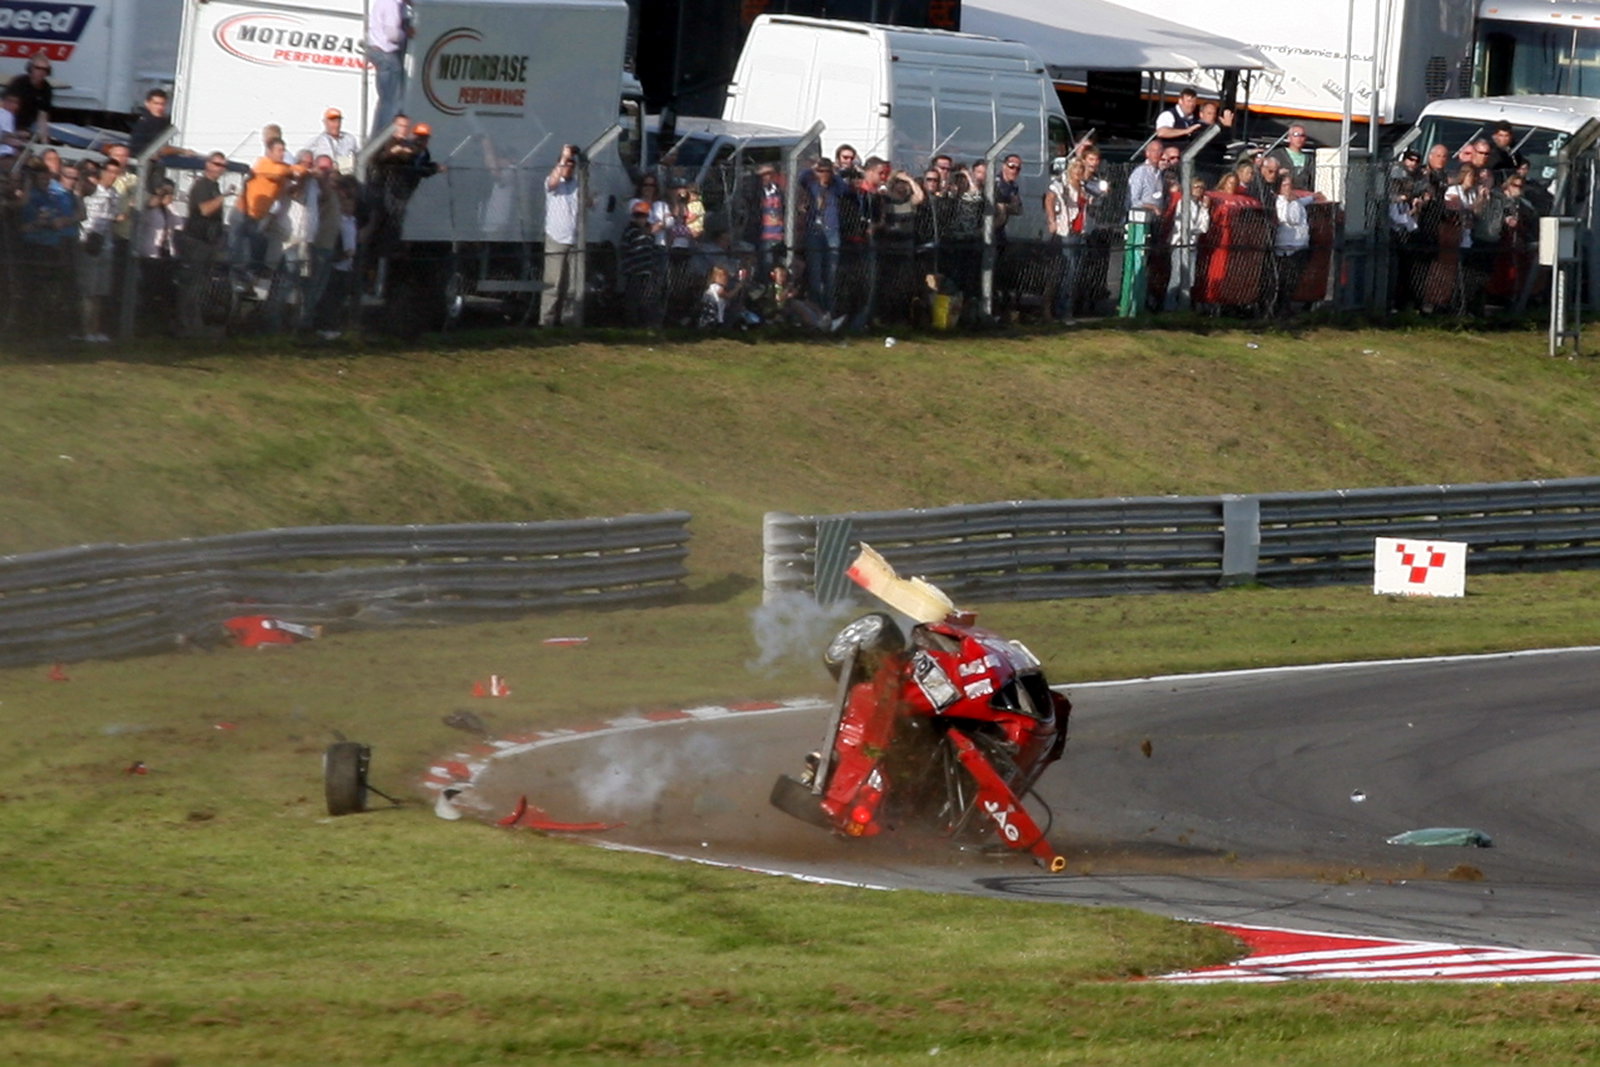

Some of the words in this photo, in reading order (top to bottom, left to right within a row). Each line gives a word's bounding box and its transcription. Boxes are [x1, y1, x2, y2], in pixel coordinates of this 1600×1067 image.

[237, 25, 368, 55] MOTORBAS
[273, 48, 376, 70] PERFORMAN
[437, 54, 528, 82] MOTORBASE
[458, 86, 526, 106] PERFORMANCE
